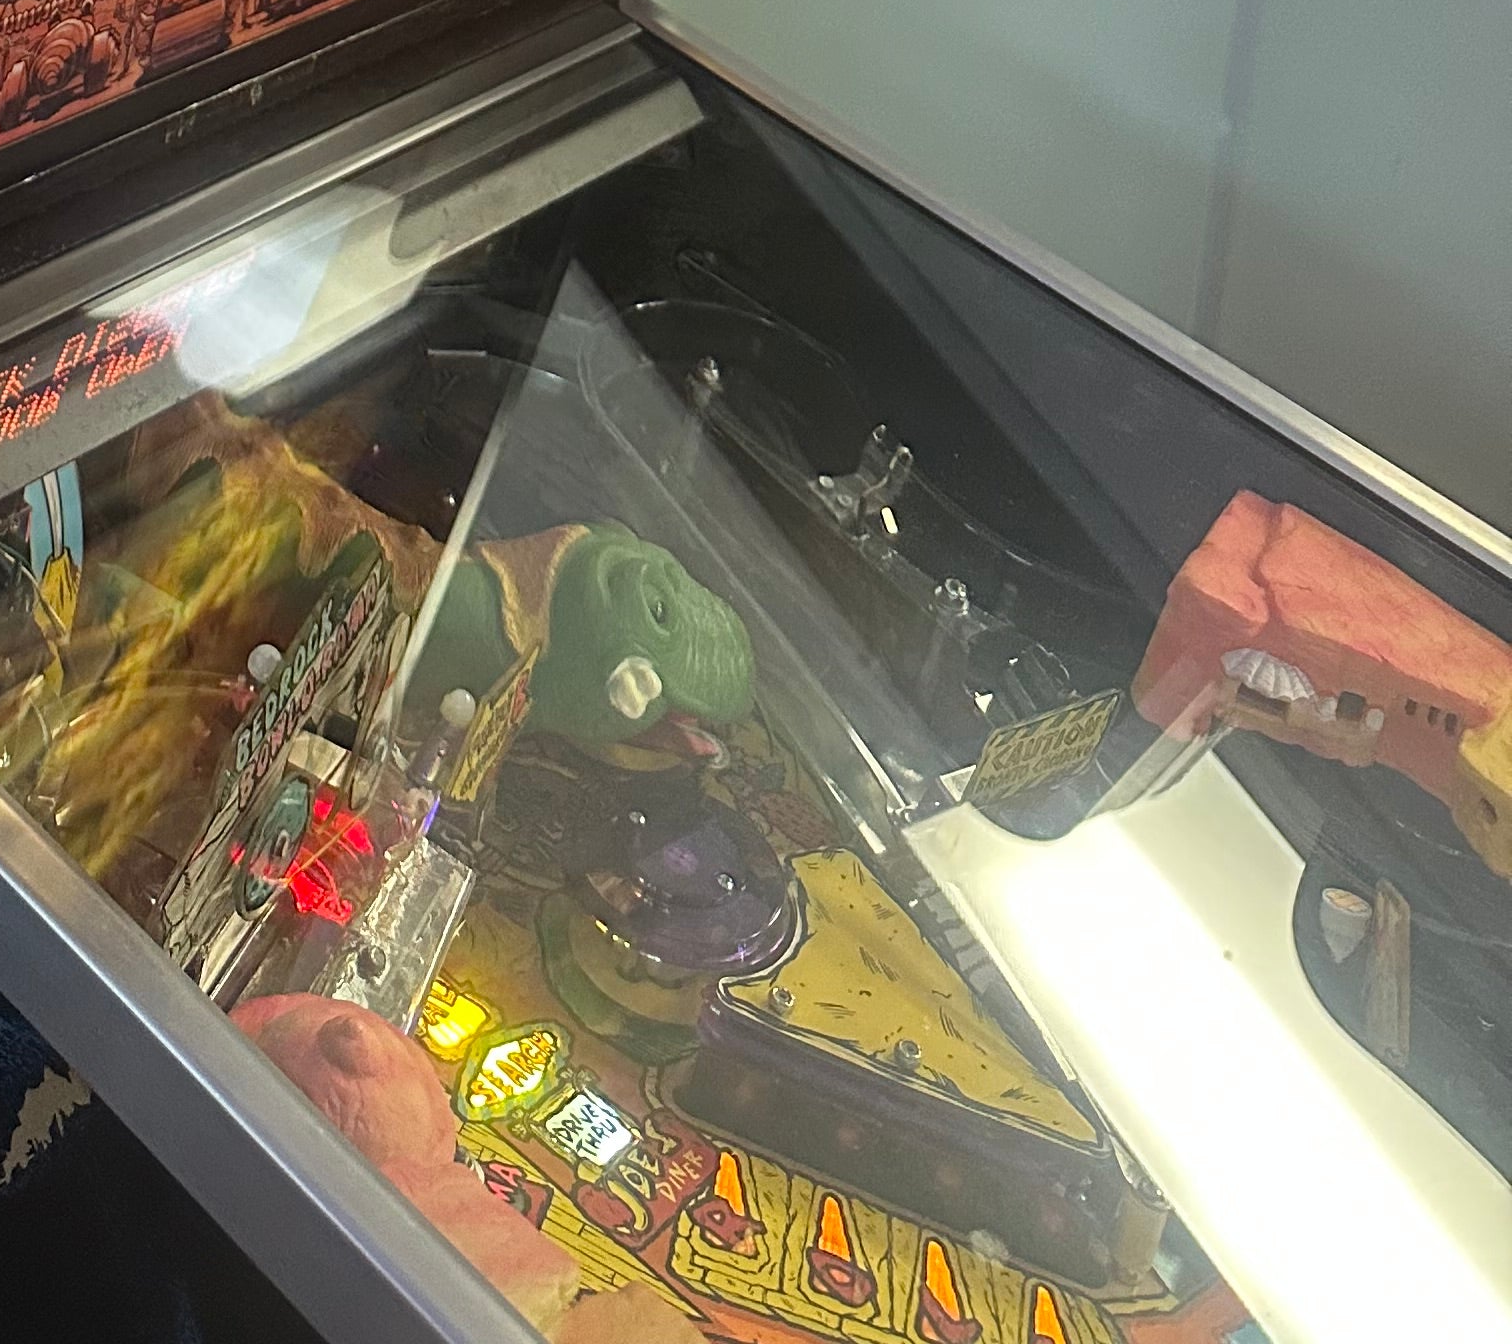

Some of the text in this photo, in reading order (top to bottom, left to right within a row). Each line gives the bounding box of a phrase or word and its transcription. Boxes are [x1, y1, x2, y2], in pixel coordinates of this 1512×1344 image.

[991, 714, 1103, 772] CAUTION
[469, 1030, 557, 1106] SEARCH
[551, 1103, 600, 1144] DRIVE
[654, 1148, 704, 1203] DINER
